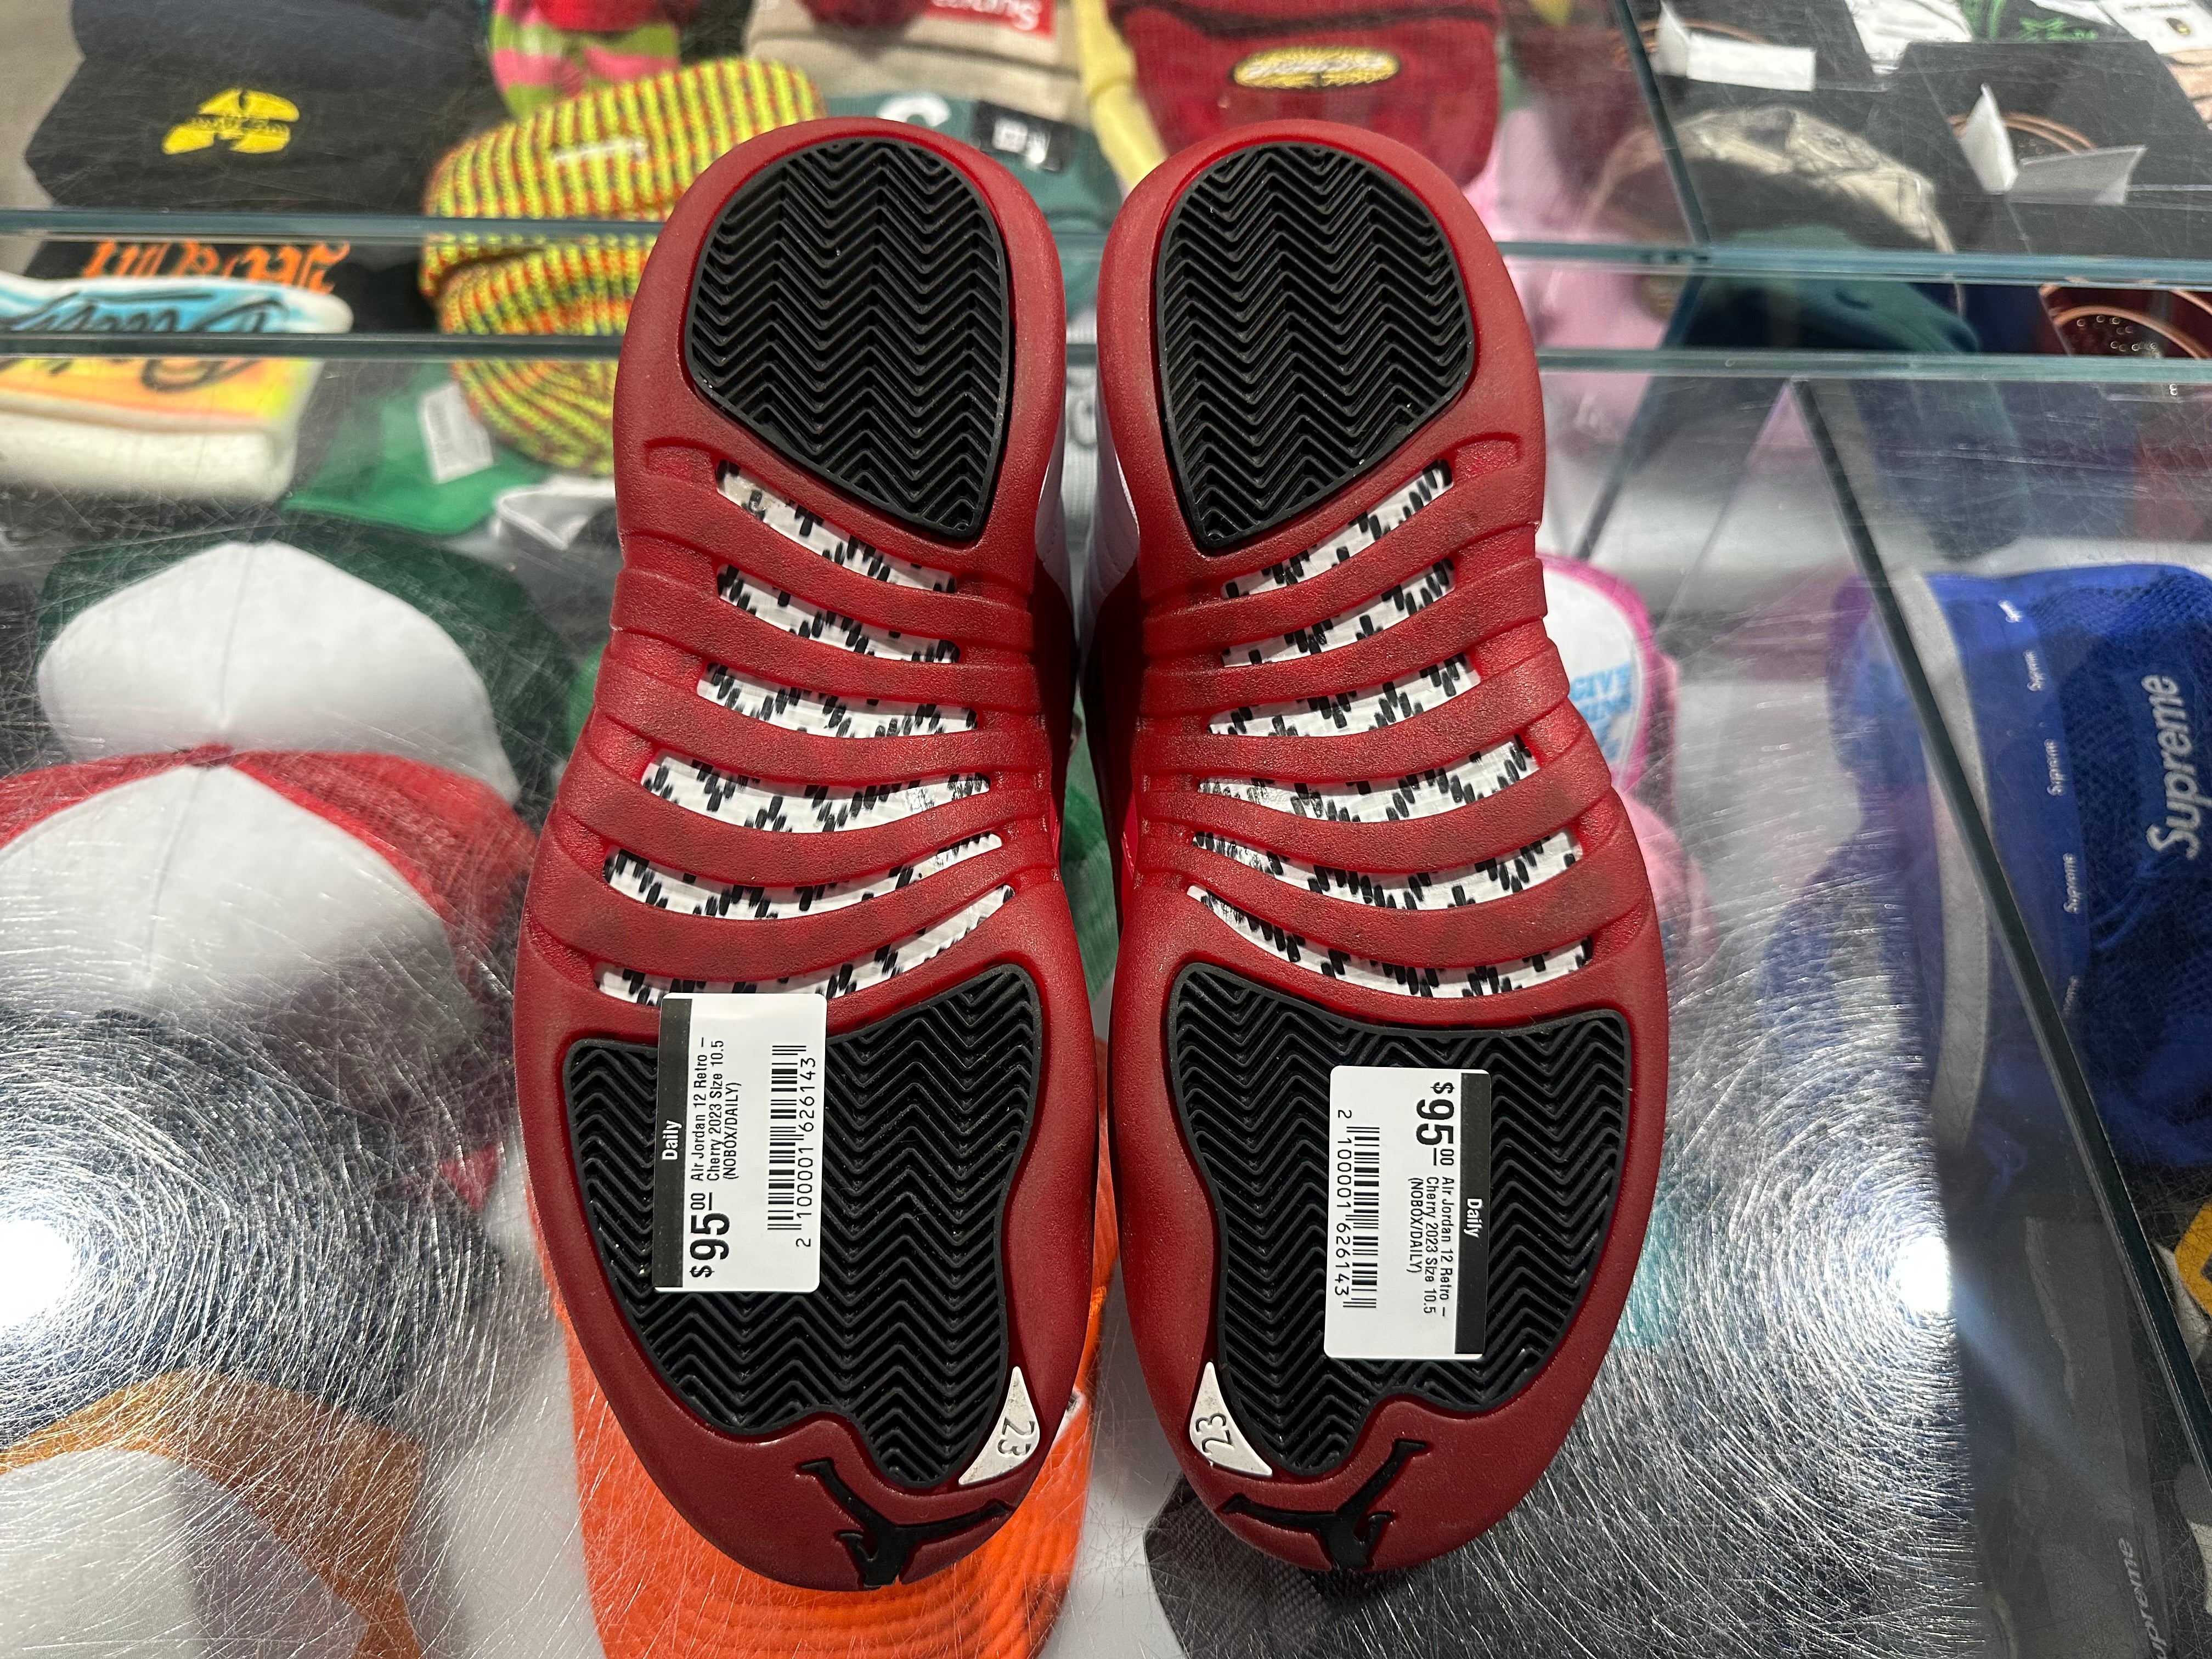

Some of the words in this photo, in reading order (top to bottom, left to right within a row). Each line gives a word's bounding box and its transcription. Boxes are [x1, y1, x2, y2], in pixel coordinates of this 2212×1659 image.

[2045, 739, 2064, 797] Supreme
[2141, 674, 2212, 860] Supreme
[2063, 853, 2081, 914] Supreme
[693, 1053, 707, 1088] Retro
[710, 1040, 724, 1068] 10.5
[693, 1093, 706, 1108] 12
[710, 1073, 723, 1098] Size
[691, 1114, 706, 1159] Jordan
[709, 1103, 723, 1135] 2023
[723, 1081, 742, 1181] (NOBOX/DAILY)
[662, 1119, 682, 1160] Daily
[691, 1163, 705, 1181] Air
[707, 1139, 723, 1181] Cherry
[1423, 1176, 1440, 1217] Cherry
[1441, 1176, 1454, 1196] Air
[1406, 1177, 1423, 1273] (NOBOX/DAILY)
[1424, 1222, 1438, 1252] 2023
[1440, 1198, 1454, 1242] Jordan
[1463, 1198, 1483, 1238] Daily
[1424, 1257, 1437, 1283] Size
[1440, 1248, 1453, 1262] 12
[1423, 1288, 1436, 1314] 10.5
[1439, 1267, 1453, 1301] Retro
[997, 1417, 1036, 1457] 23
[1195, 1412, 1231, 1454] 23
[2118, 1537, 2168, 1659] upreme
